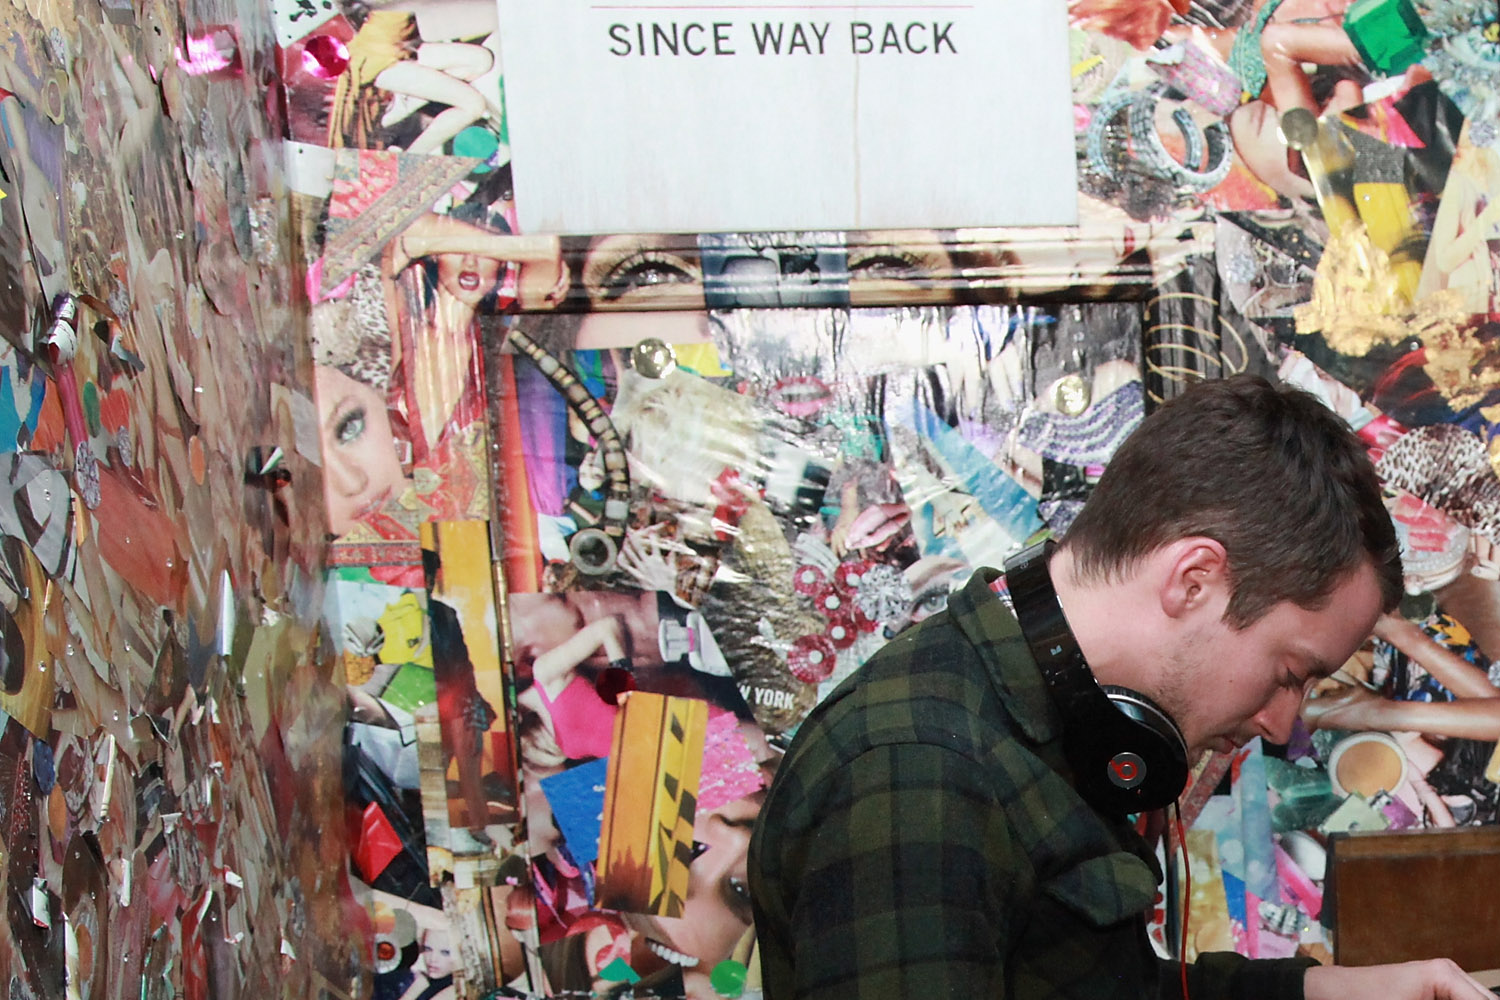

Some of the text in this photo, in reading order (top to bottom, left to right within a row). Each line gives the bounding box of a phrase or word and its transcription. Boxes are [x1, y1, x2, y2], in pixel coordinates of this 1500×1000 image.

[608, 21, 958, 57] SINCE WAY BACK
[754, 686, 795, 710] YORK
